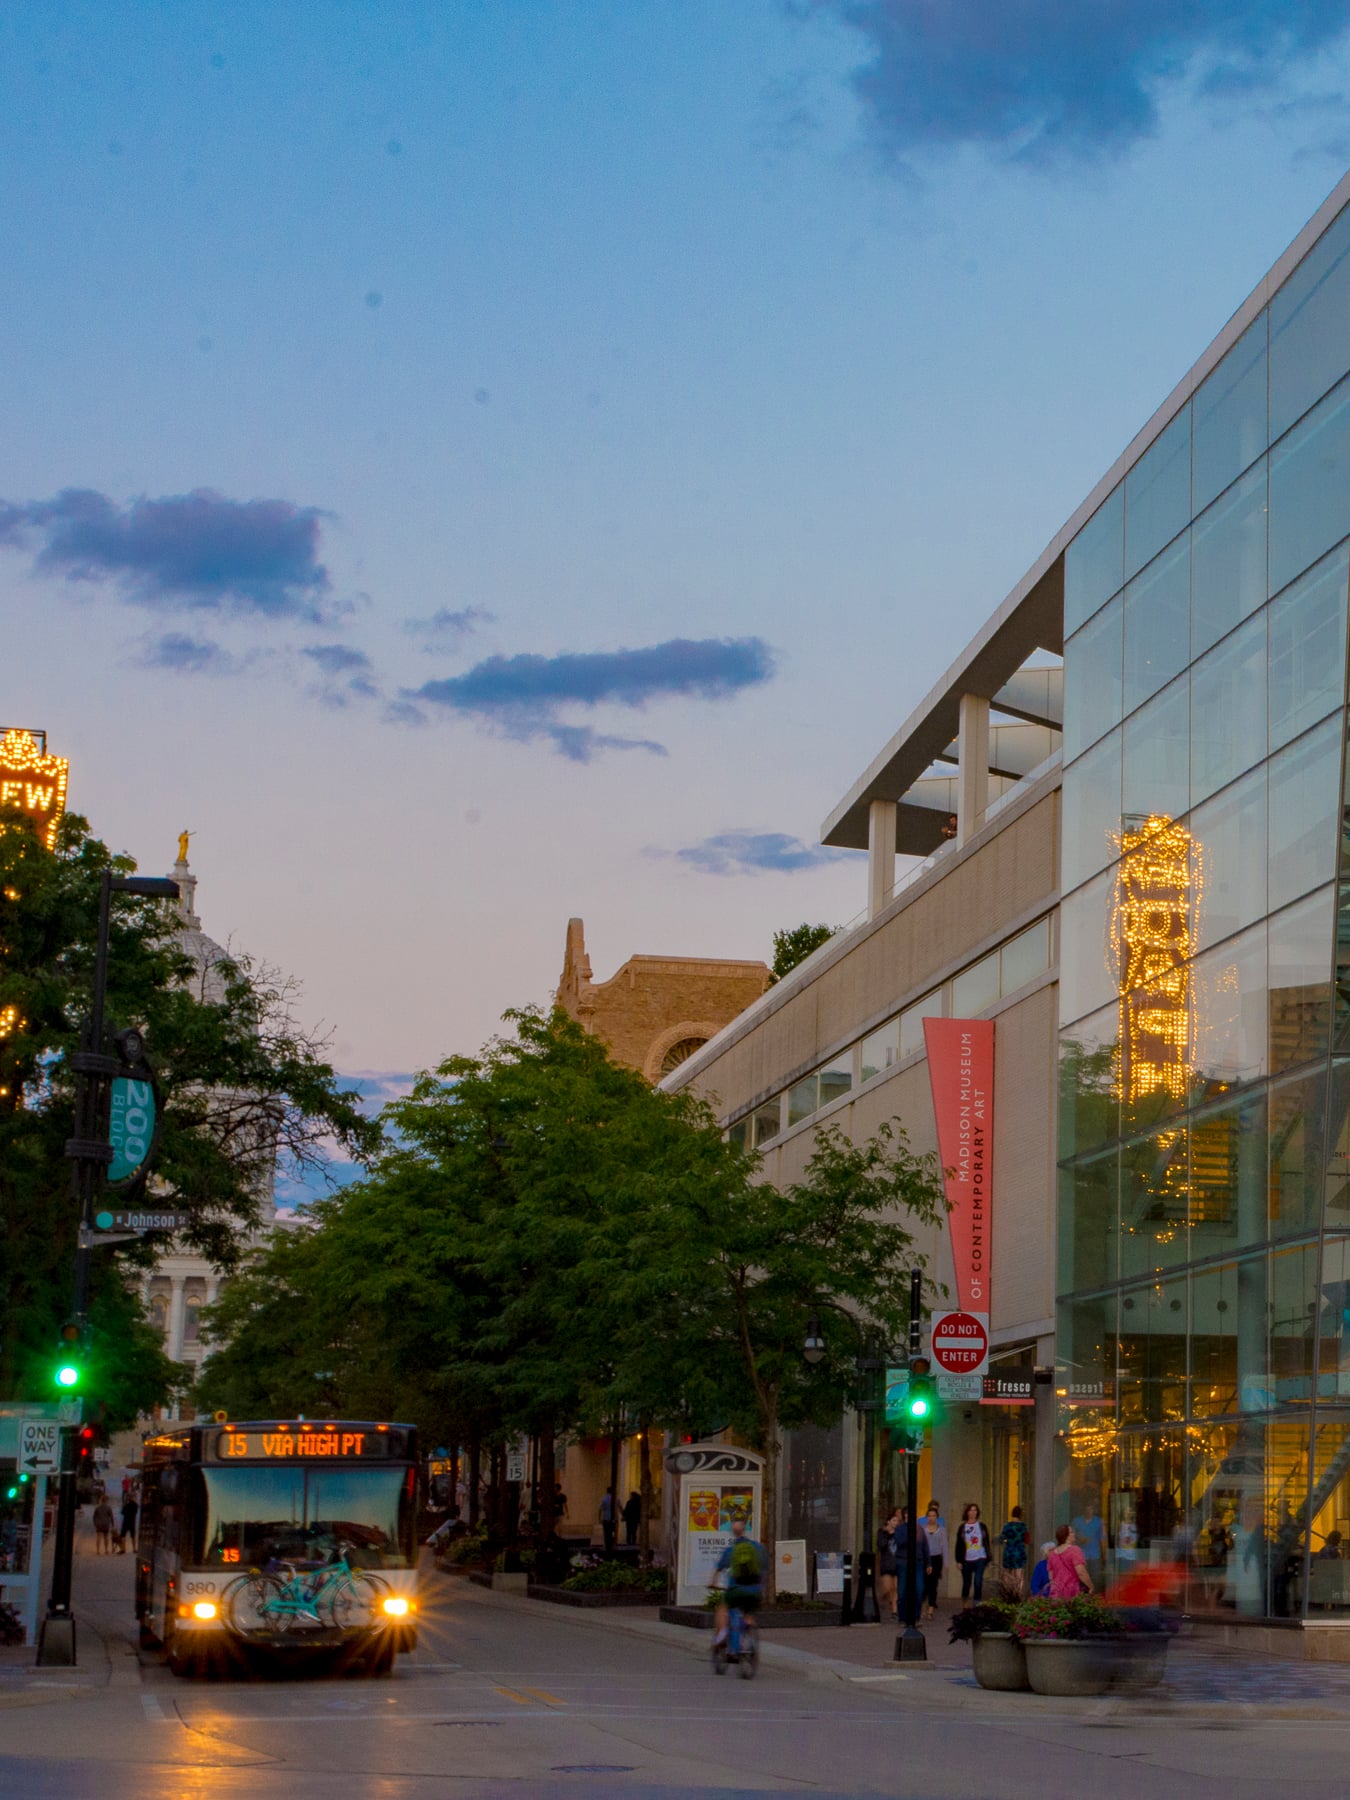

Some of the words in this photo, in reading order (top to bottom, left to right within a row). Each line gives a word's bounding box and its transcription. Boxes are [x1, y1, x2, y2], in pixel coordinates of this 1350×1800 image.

[960, 1032, 972, 1101] MUSEUM
[974, 1088, 985, 1120] ART
[125, 1079, 149, 1163] 200
[959, 1105, 971, 1182] MADISON
[971, 1126, 984, 1272] CONTEMPORARY
[124, 1211, 175, 1228] Johnson
[970, 1277, 982, 1299] OF
[941, 1324, 955, 1335] DO
[958, 1324, 978, 1335] NOT
[942, 1351, 977, 1362] ENTER
[996, 1379, 1031, 1393] fresco
[26, 1426, 56, 1440] ONE
[23, 1440, 57, 1454] WAY
[227, 1433, 248, 1456] 15
[262, 1433, 294, 1456] VIA
[297, 1433, 338, 1456] HIGH
[342, 1433, 365, 1456] PT
[510, 1467, 522, 1479] 15
[699, 1537, 726, 1546] TAKING
[222, 1547, 240, 1562] 15
[186, 1582, 216, 1595] 980
[1331, 1589, 1340, 1600] in
